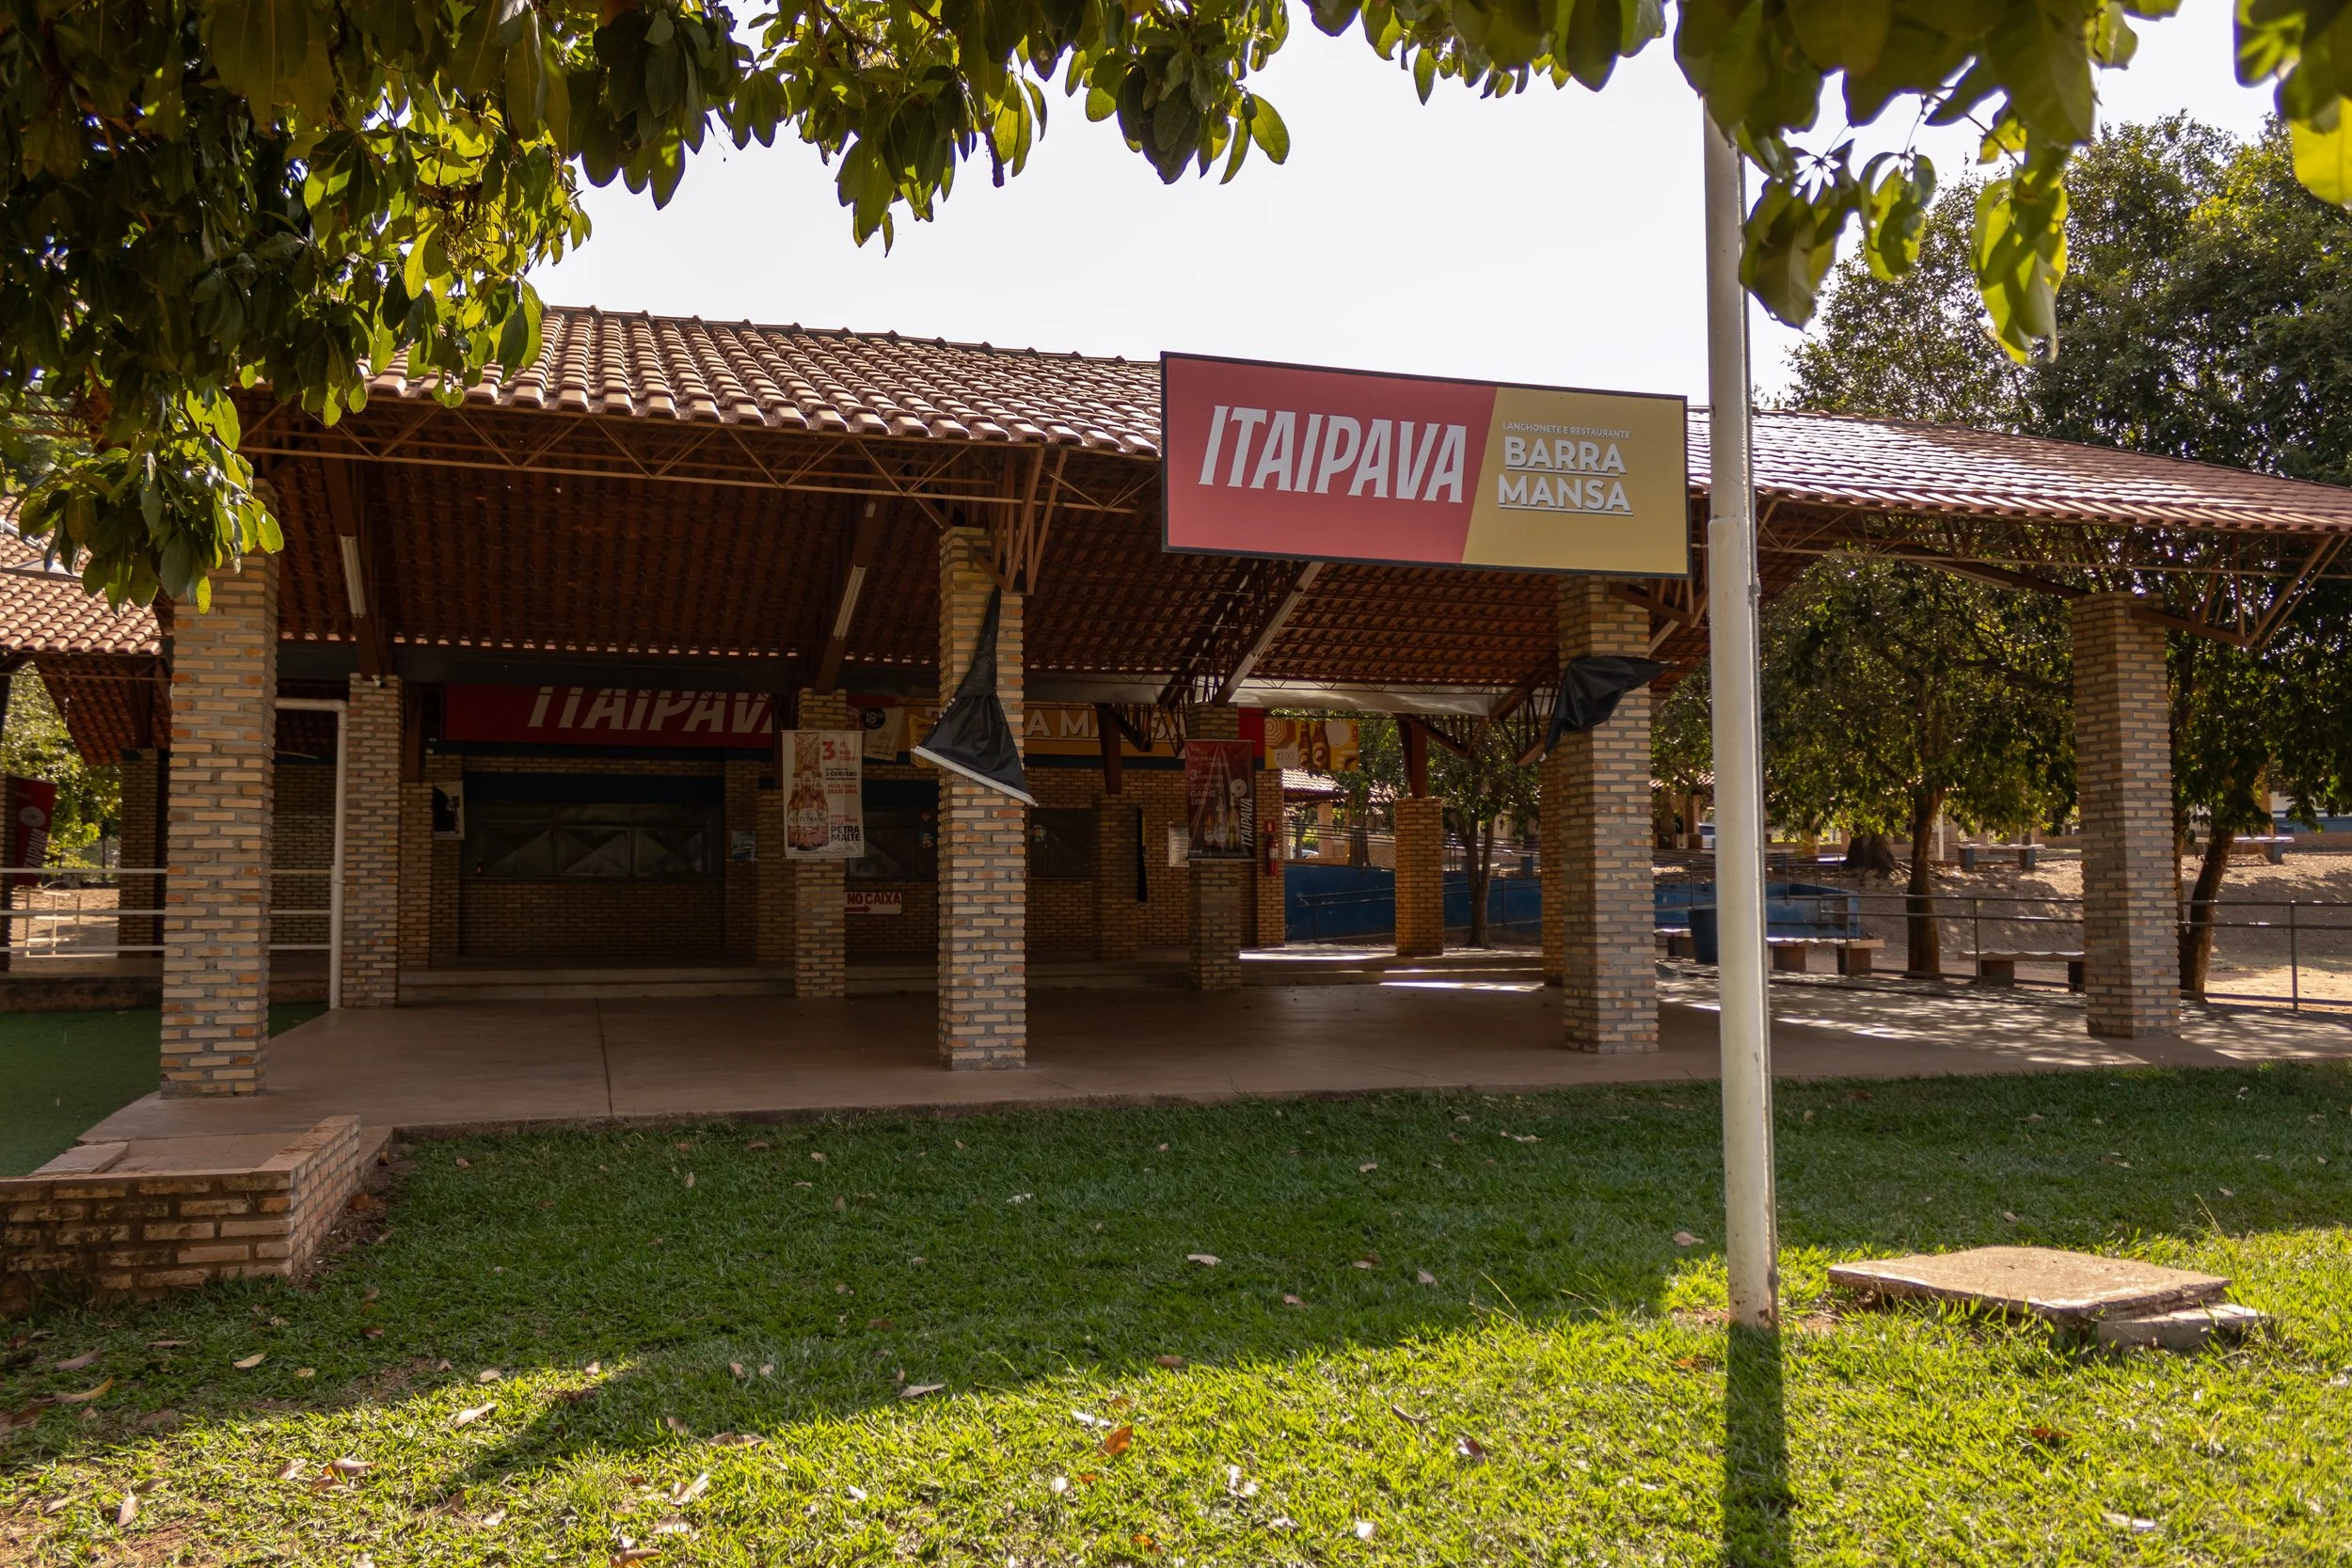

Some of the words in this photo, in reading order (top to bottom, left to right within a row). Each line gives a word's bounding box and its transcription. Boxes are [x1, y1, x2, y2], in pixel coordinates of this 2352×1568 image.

[1502, 421, 1561, 435] LANCHONETE
[1570, 427, 1631, 439] RESTAURANTE
[1198, 404, 1467, 503] ITAIPAVA
[1505, 436, 1627, 474] BARRA
[1498, 473, 1632, 513] MANSA
[831, 825, 860, 833] PETRA
[1240, 798, 1253, 847] ITAIPAVA
[831, 833, 861, 842] MALTE
[847, 893, 864, 905] NO
[866, 892, 901, 905] CAIXA
